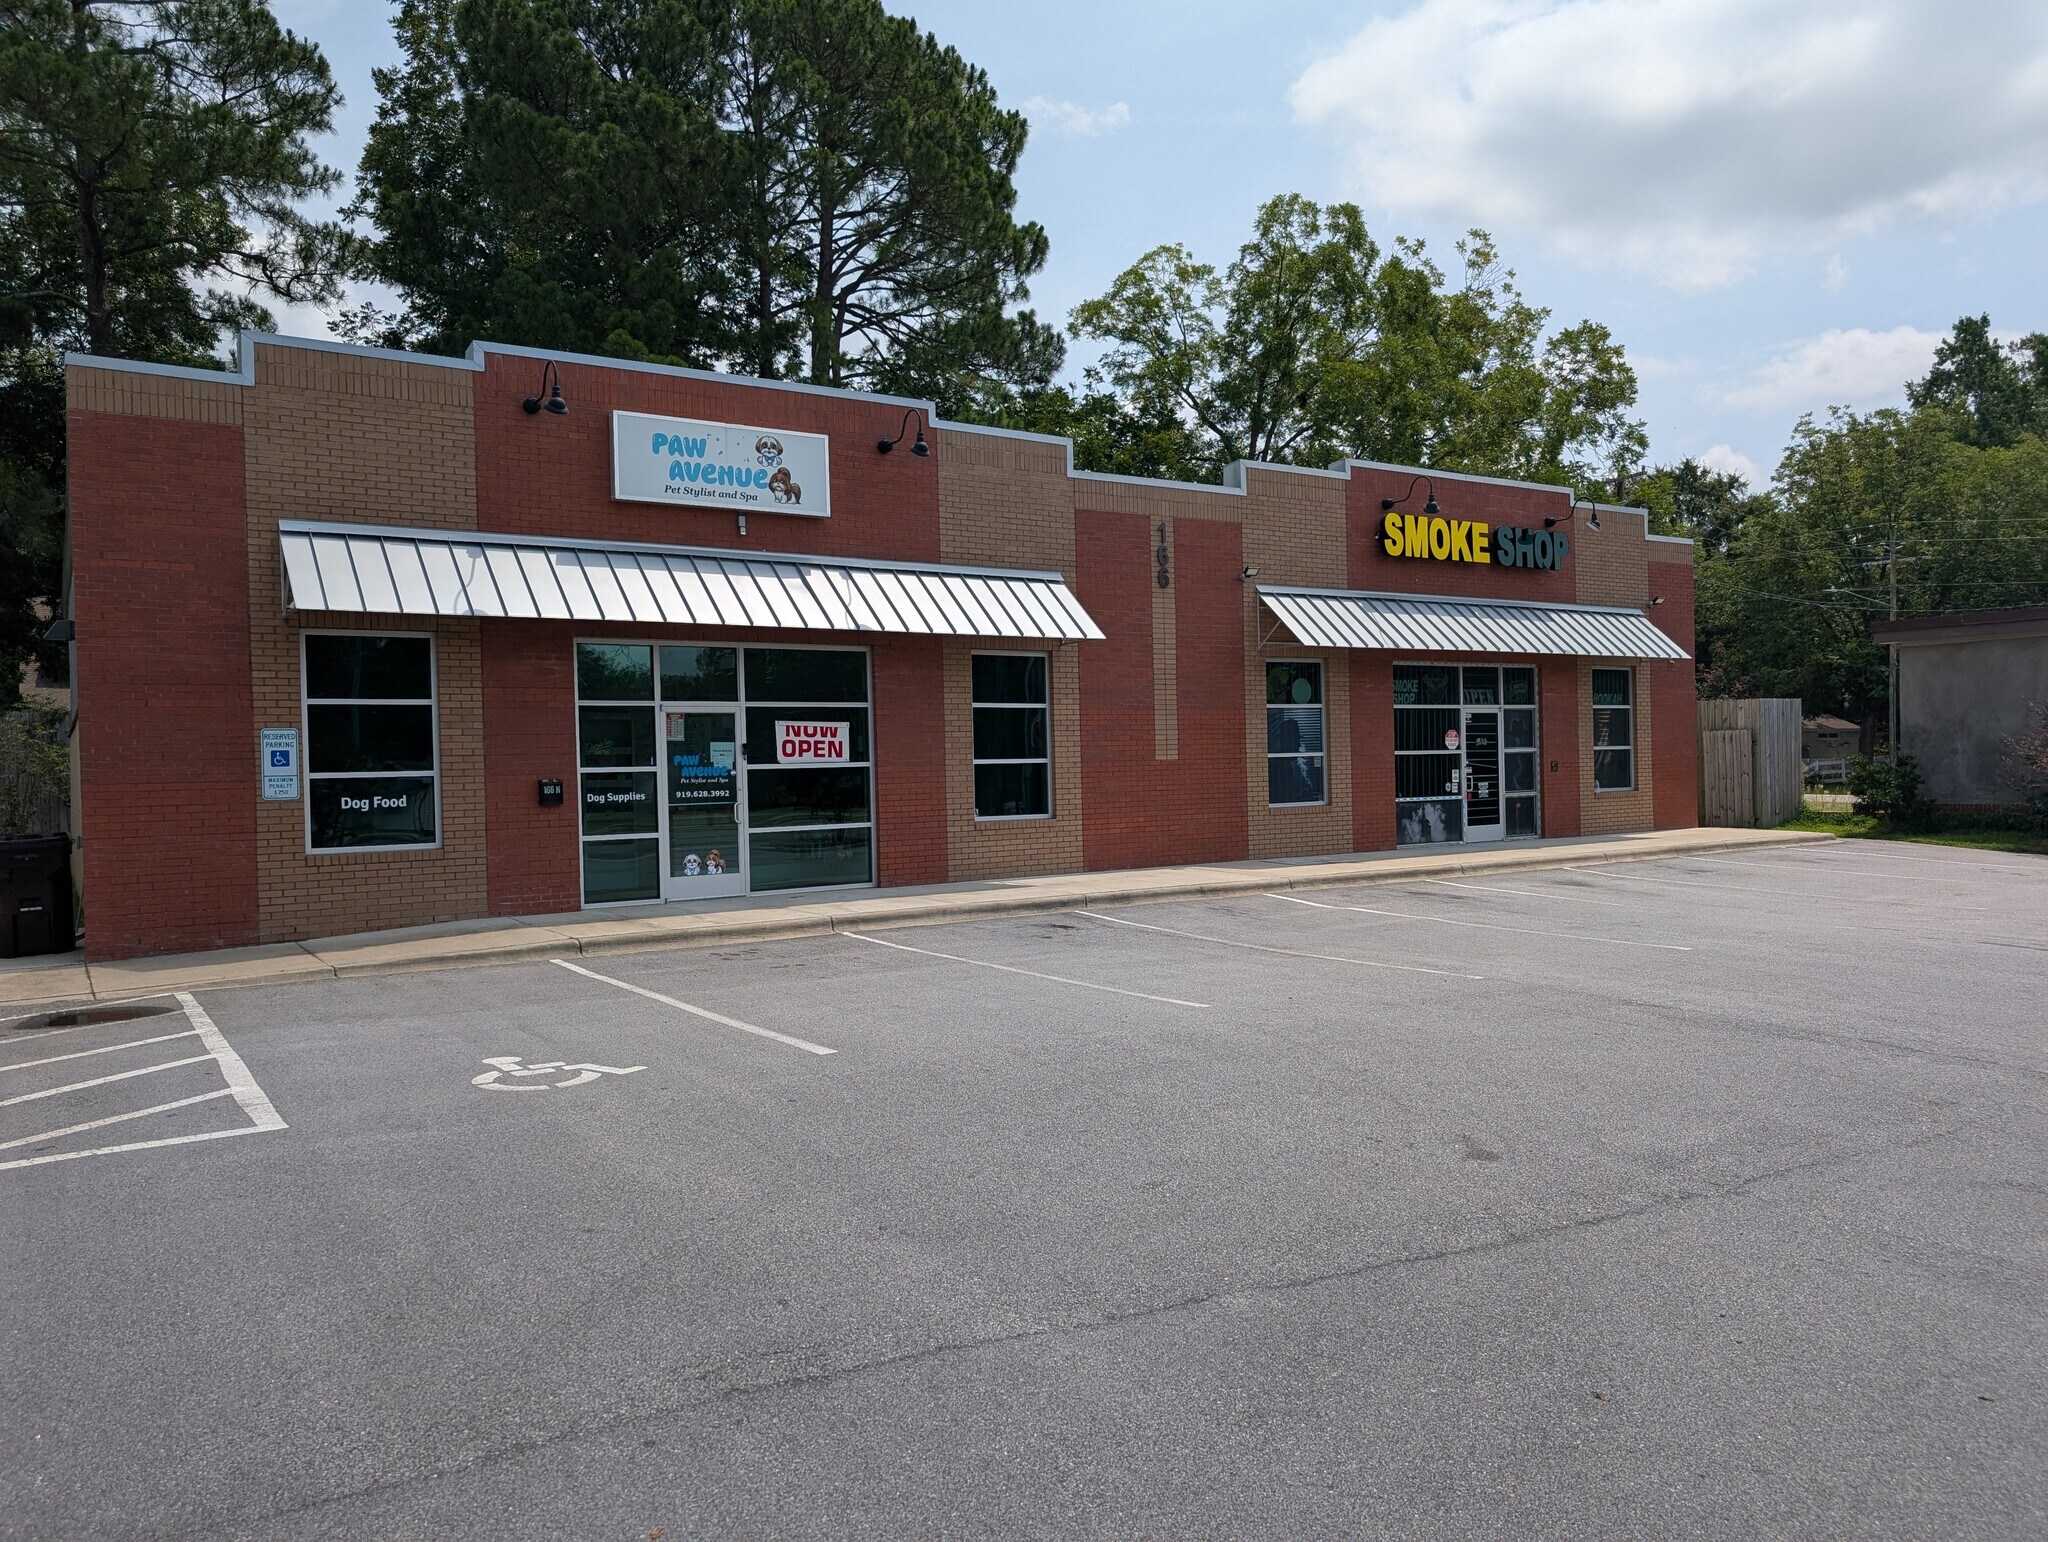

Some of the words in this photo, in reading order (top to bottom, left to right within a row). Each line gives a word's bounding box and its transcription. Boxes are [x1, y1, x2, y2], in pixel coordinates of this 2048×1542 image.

[651, 432, 707, 459] PAW
[664, 484, 681, 495] Pet
[683, 486, 717, 498] Stylist
[719, 490, 737, 500] and
[739, 491, 758, 502] Spa
[1384, 512, 1491, 564] SMOKE
[1496, 525, 1569, 570] SHOP
[1157, 521, 1169, 589] 166
[1393, 693, 1415, 704] SHOP
[785, 725, 838, 738] NOW
[781, 740, 843, 758] OPEN
[673, 754, 700, 767] PAW
[587, 793, 605, 803] Dog
[606, 791, 646, 803] Supplies
[675, 790, 730, 798] 919.628.3992
[341, 797, 370, 811] Dog
[373, 795, 407, 808] Food
